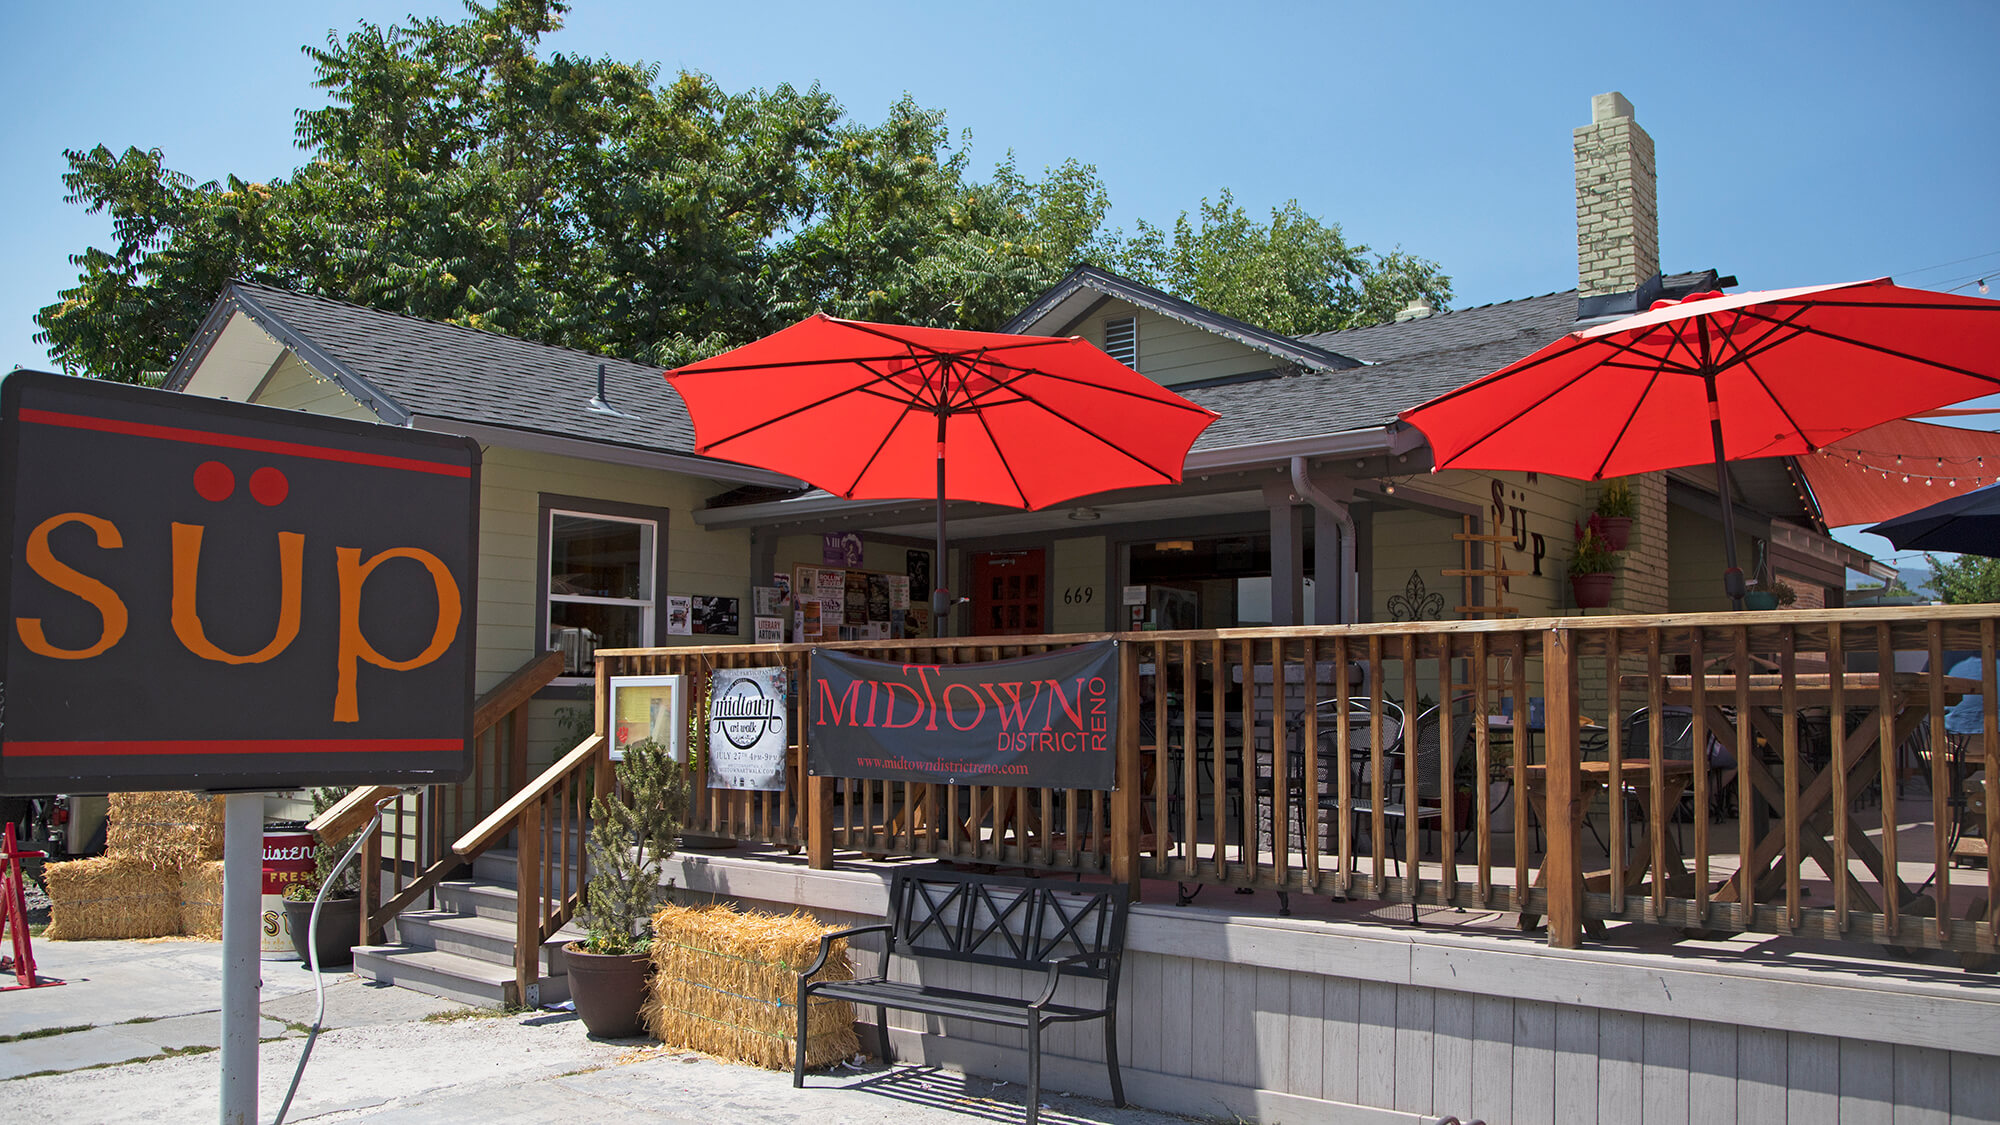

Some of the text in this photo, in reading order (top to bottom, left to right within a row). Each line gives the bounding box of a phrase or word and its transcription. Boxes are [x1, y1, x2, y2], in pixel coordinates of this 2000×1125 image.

[15, 460, 462, 723] süp
[1064, 586, 1093, 605] 669
[758, 620, 781, 630] LITERARY
[758, 629, 781, 640] ARTOWN
[816, 664, 1086, 732] MIDTOWN
[712, 693, 780, 727] midtown
[1088, 677, 1107, 751] RENO
[998, 732, 1089, 752] DISTRICT
[716, 751, 731, 760] JULY
[857, 755, 1029, 775] www.midtowndistrictreno.com
[270, 871, 310, 883] FRES
